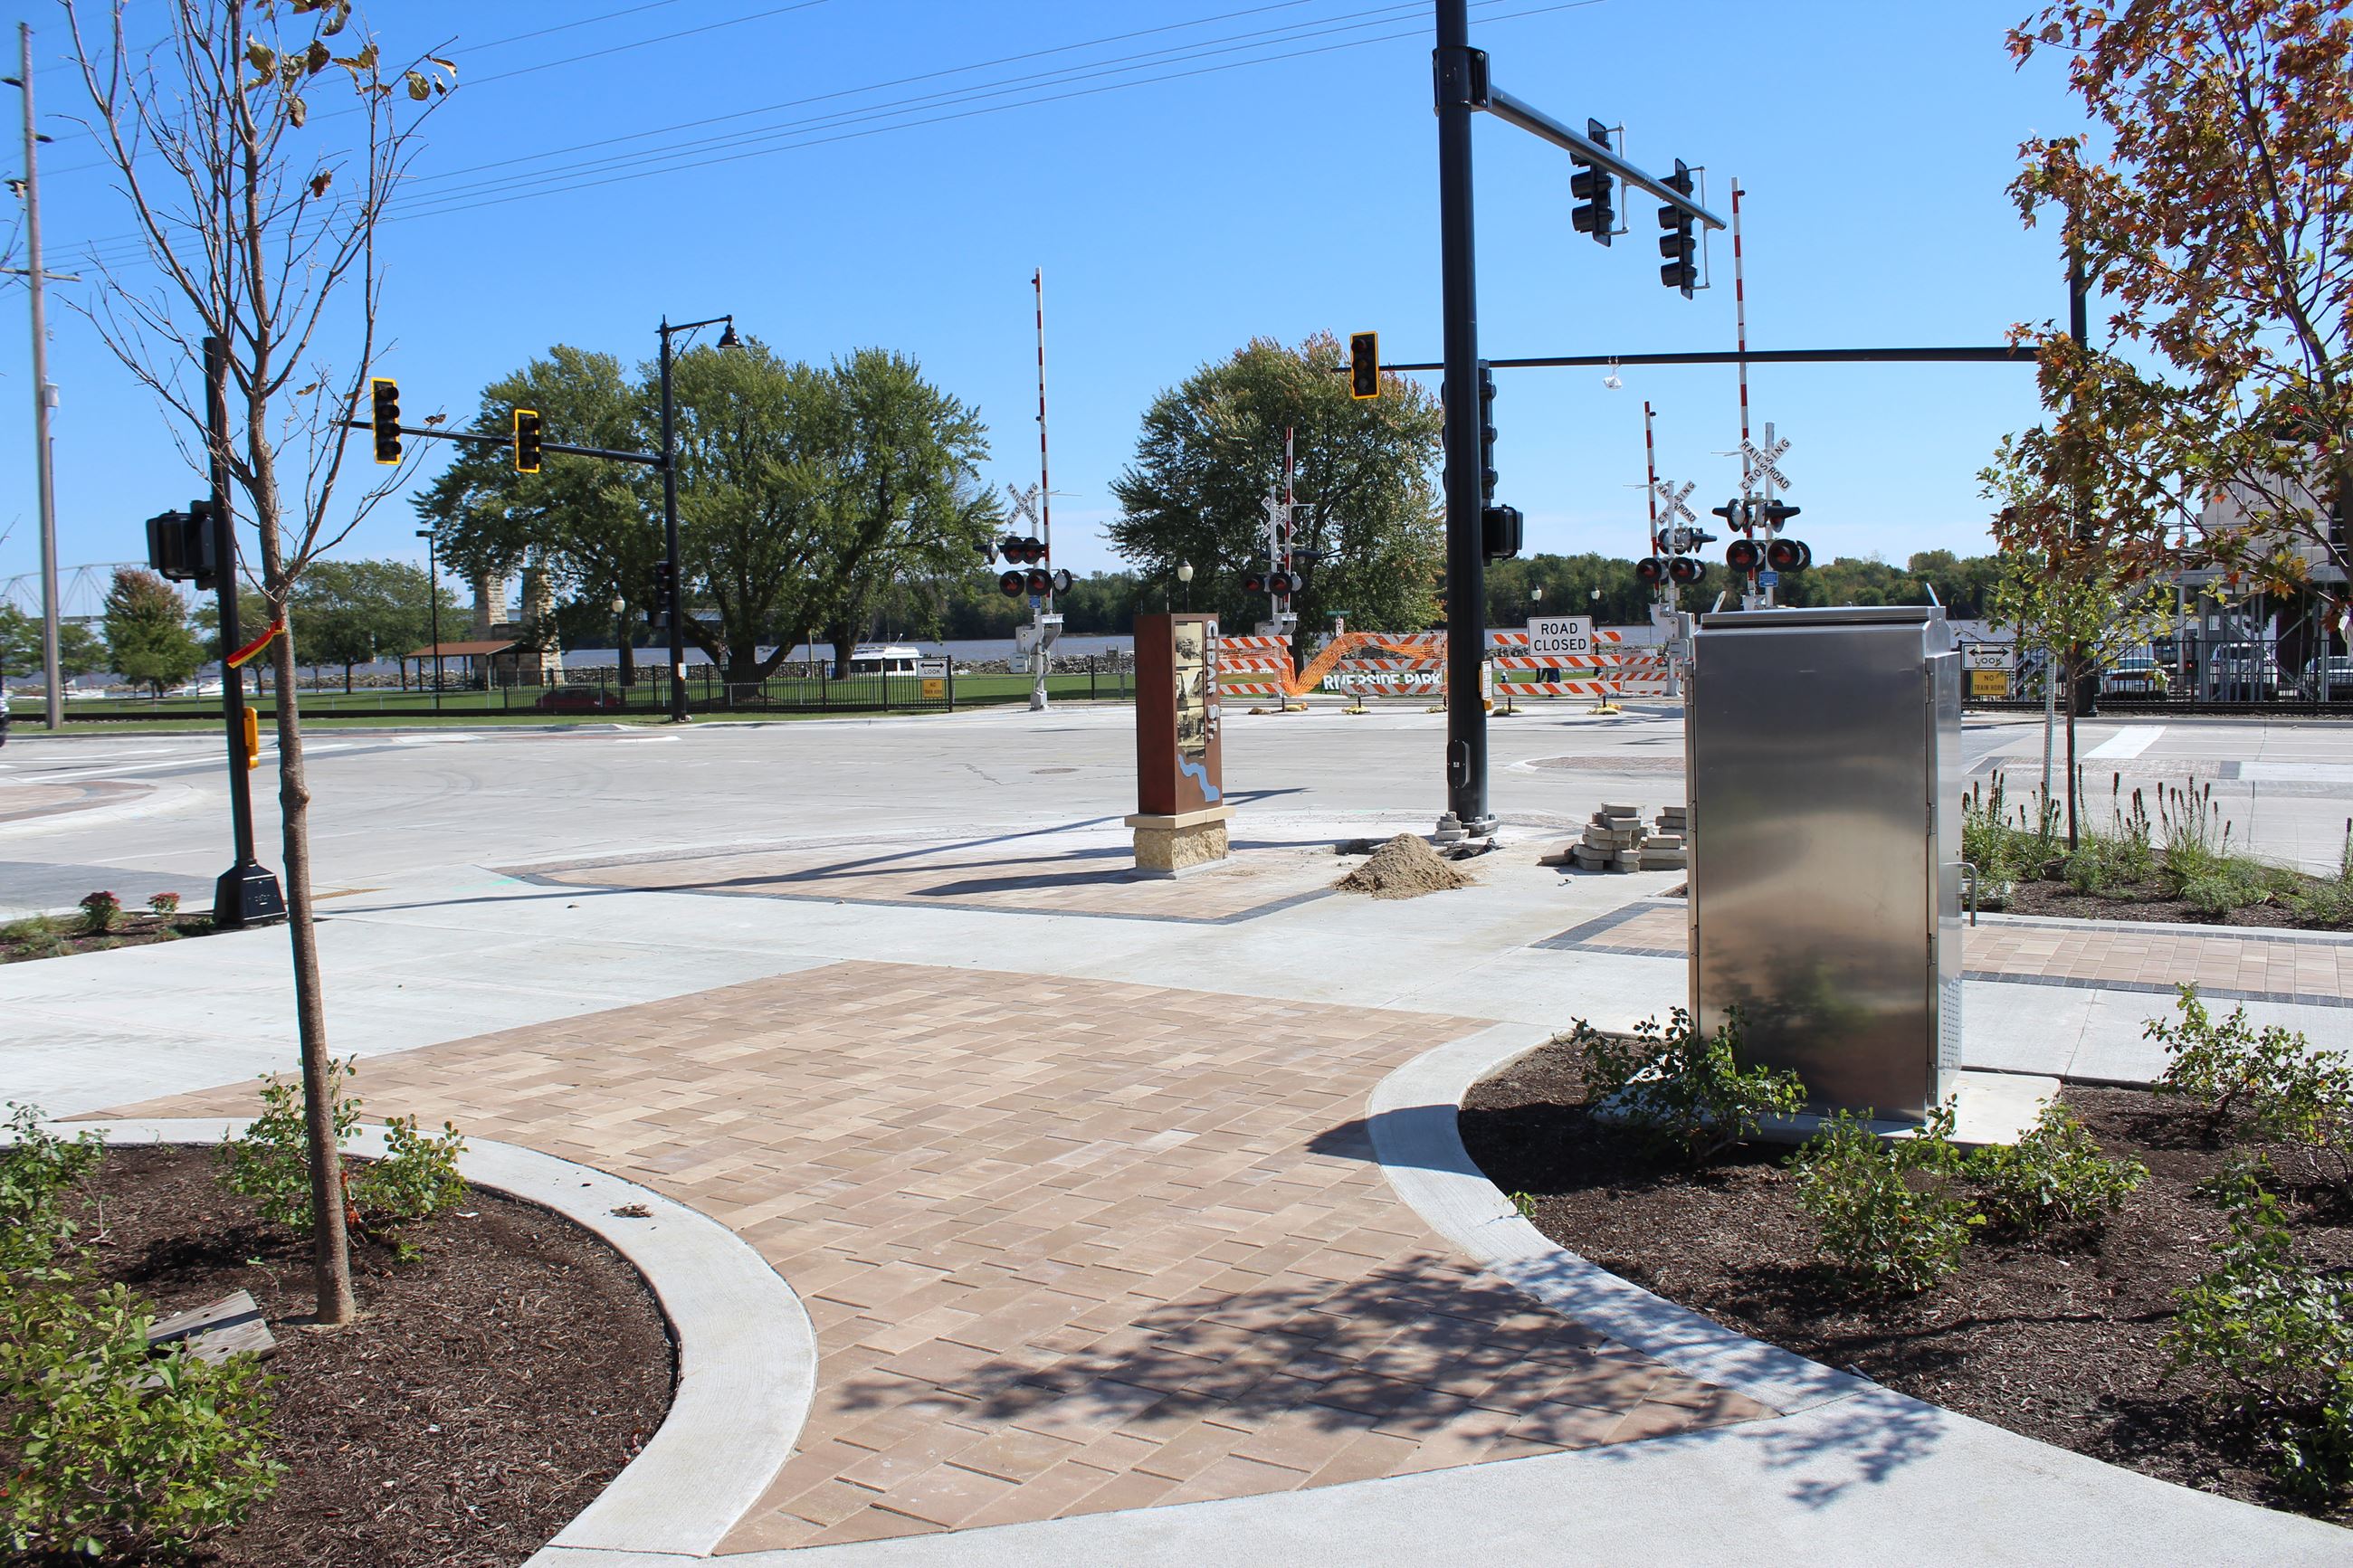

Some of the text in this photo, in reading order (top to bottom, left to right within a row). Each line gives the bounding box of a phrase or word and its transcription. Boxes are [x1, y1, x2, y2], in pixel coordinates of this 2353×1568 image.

[1741, 441, 1790, 489] RAILROAD
[1741, 439, 1790, 491] CROSSING
[1007, 483, 1038, 524] CROSSING
[1008, 484, 1038, 524] RAILROAD
[1657, 486, 1696, 522] RAROAD
[1658, 481, 1695, 524] CRSSING
[1534, 638, 1586, 651] CLOSED
[1541, 622, 1578, 635] ROAD
[1405, 674, 1442, 685] PARK
